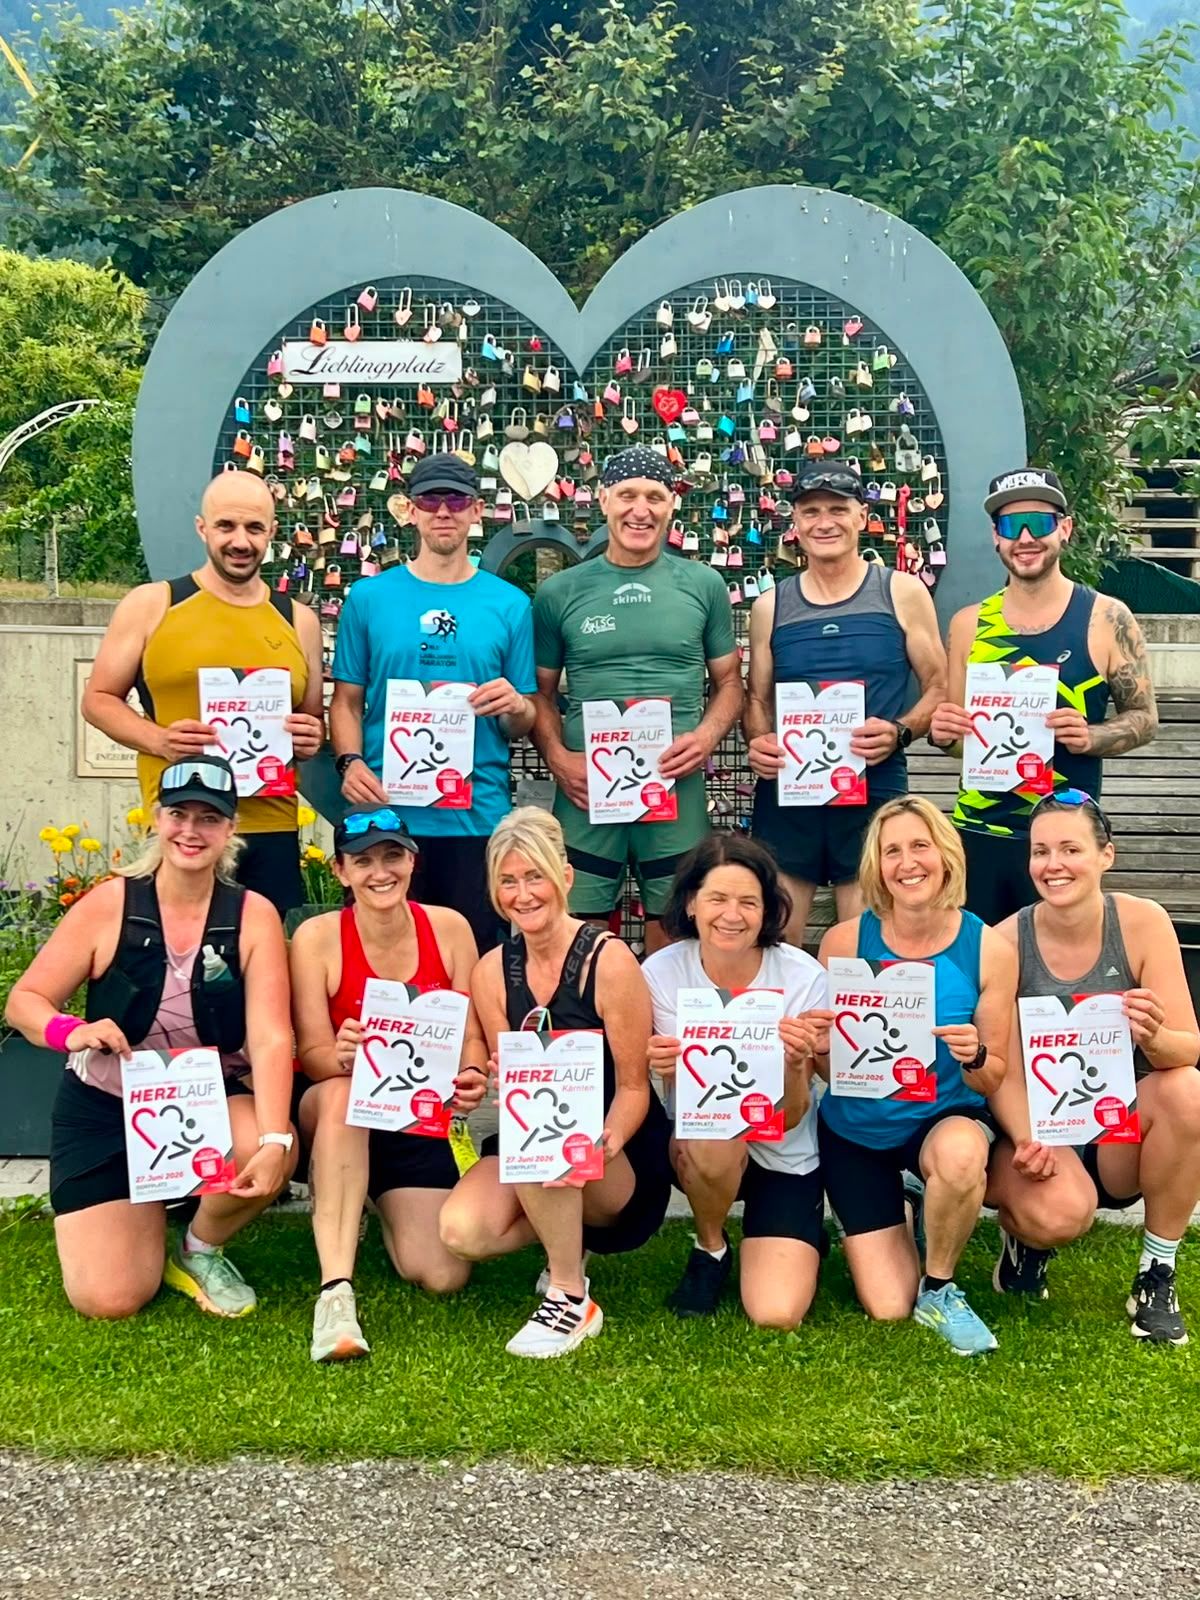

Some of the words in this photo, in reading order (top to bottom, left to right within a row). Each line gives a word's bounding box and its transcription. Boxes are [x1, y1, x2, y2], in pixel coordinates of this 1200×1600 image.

[289, 346, 446, 380] Lieblingsplatz
[612, 593, 651, 605] skinfit
[206, 700, 285, 713] HERZLAUF
[970, 695, 1050, 709] HERZLAUF
[390, 711, 469, 725] HERZLAUF
[782, 712, 858, 725] HERZLAUF
[591, 729, 666, 743] HERZLAUF
[835, 993, 928, 1009] HERZLAUF
[892, 1011, 926, 1020] Kärnten
[366, 1016, 457, 1040] HERZLAUF
[682, 1026, 776, 1040] HERZLAUF
[740, 1042, 775, 1051] Kärnten
[1029, 1030, 1123, 1049] HERZLAUF
[505, 1067, 596, 1083] HERZLAUF
[847, 1072, 864, 1080] Juni
[865, 1073, 885, 1081] 2026
[130, 1082, 217, 1104] HERZLAUF
[365, 1101, 383, 1109] Juni
[693, 1112, 711, 1120] Juni
[711, 1112, 732, 1120] 2026
[1048, 1119, 1066, 1127] Juni
[1066, 1118, 1087, 1126] 2026
